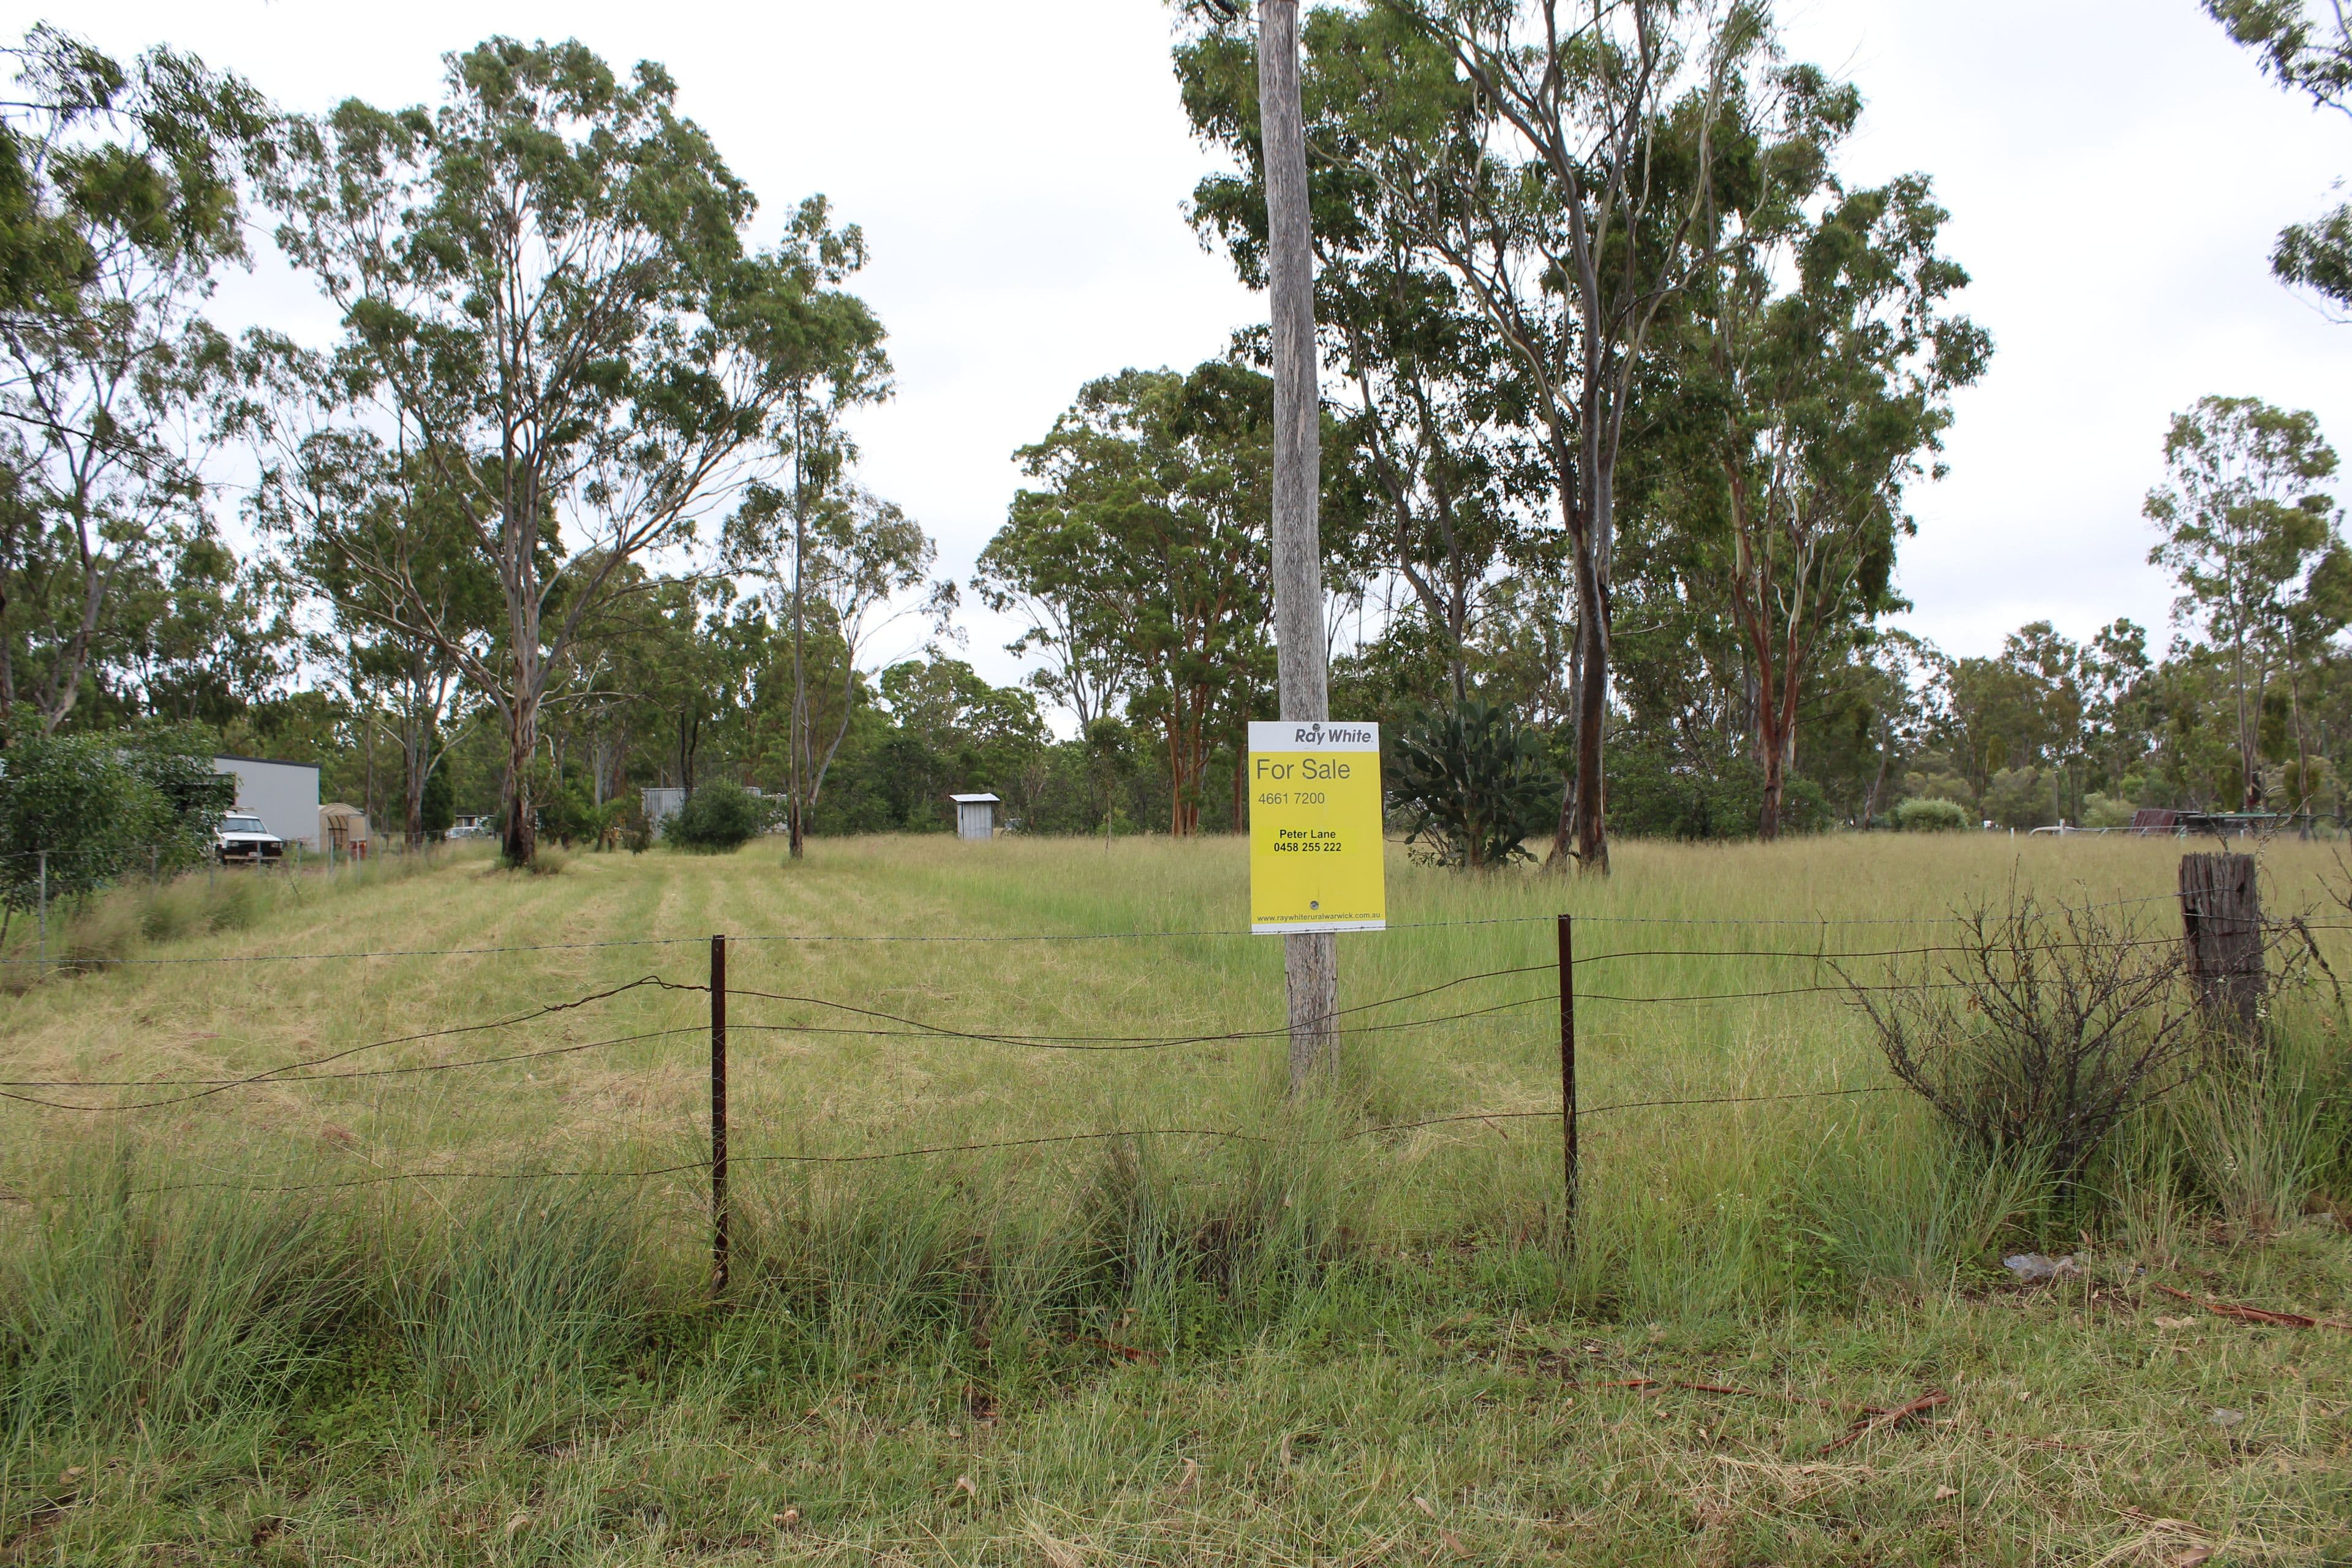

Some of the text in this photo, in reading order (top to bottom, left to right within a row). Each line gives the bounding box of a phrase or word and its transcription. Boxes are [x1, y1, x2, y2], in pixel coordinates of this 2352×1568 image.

[1295, 729, 1371, 745] Ray White
[1257, 758, 1351, 779] For Sale
[1259, 793, 1325, 804] 4661 7200
[1280, 829, 1336, 839] Peter Lane
[1302, 843, 1320, 851] 255
[1324, 843, 1341, 851] 222
[1257, 912, 1381, 922] www.raywhiteruralwarwick.com.au
